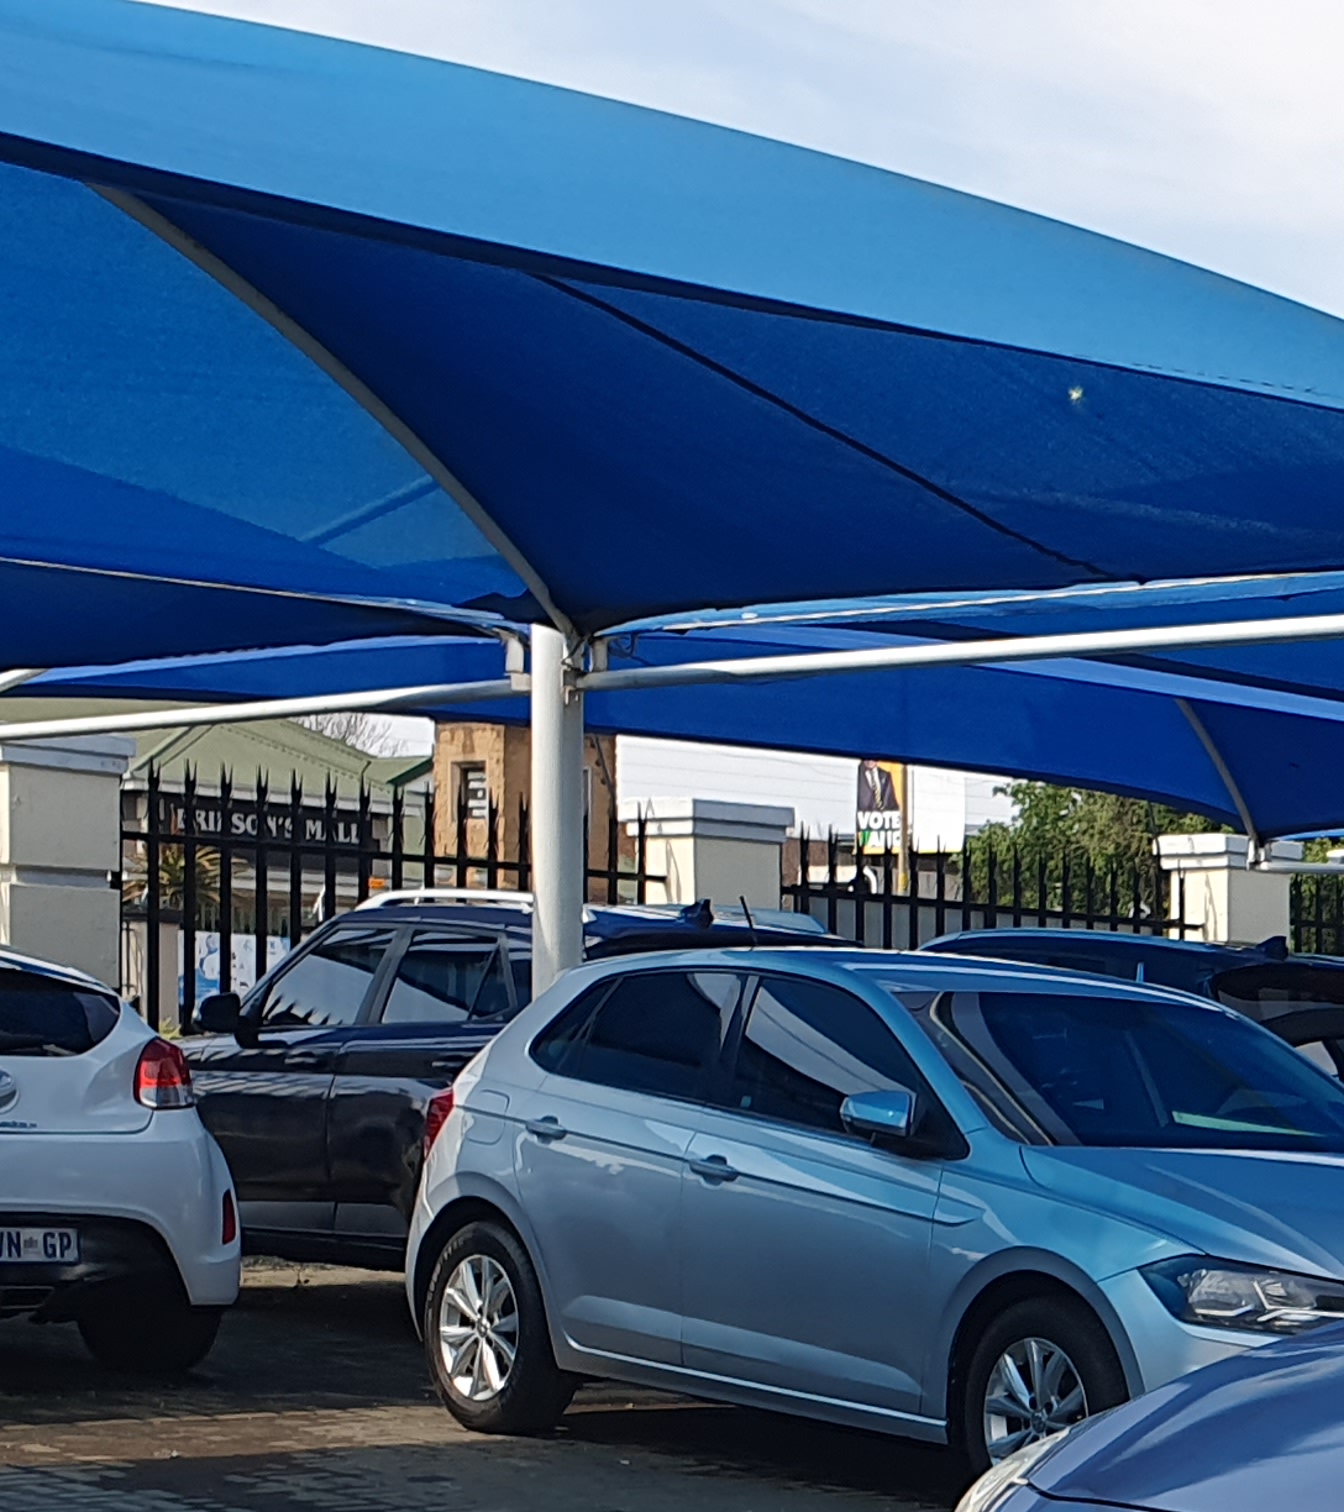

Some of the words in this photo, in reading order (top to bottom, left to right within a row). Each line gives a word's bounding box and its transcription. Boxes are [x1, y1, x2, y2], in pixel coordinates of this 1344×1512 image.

[857, 811, 901, 830] VOTE
[0, 1231, 22, 1259] N
[43, 1231, 72, 1259] GP
